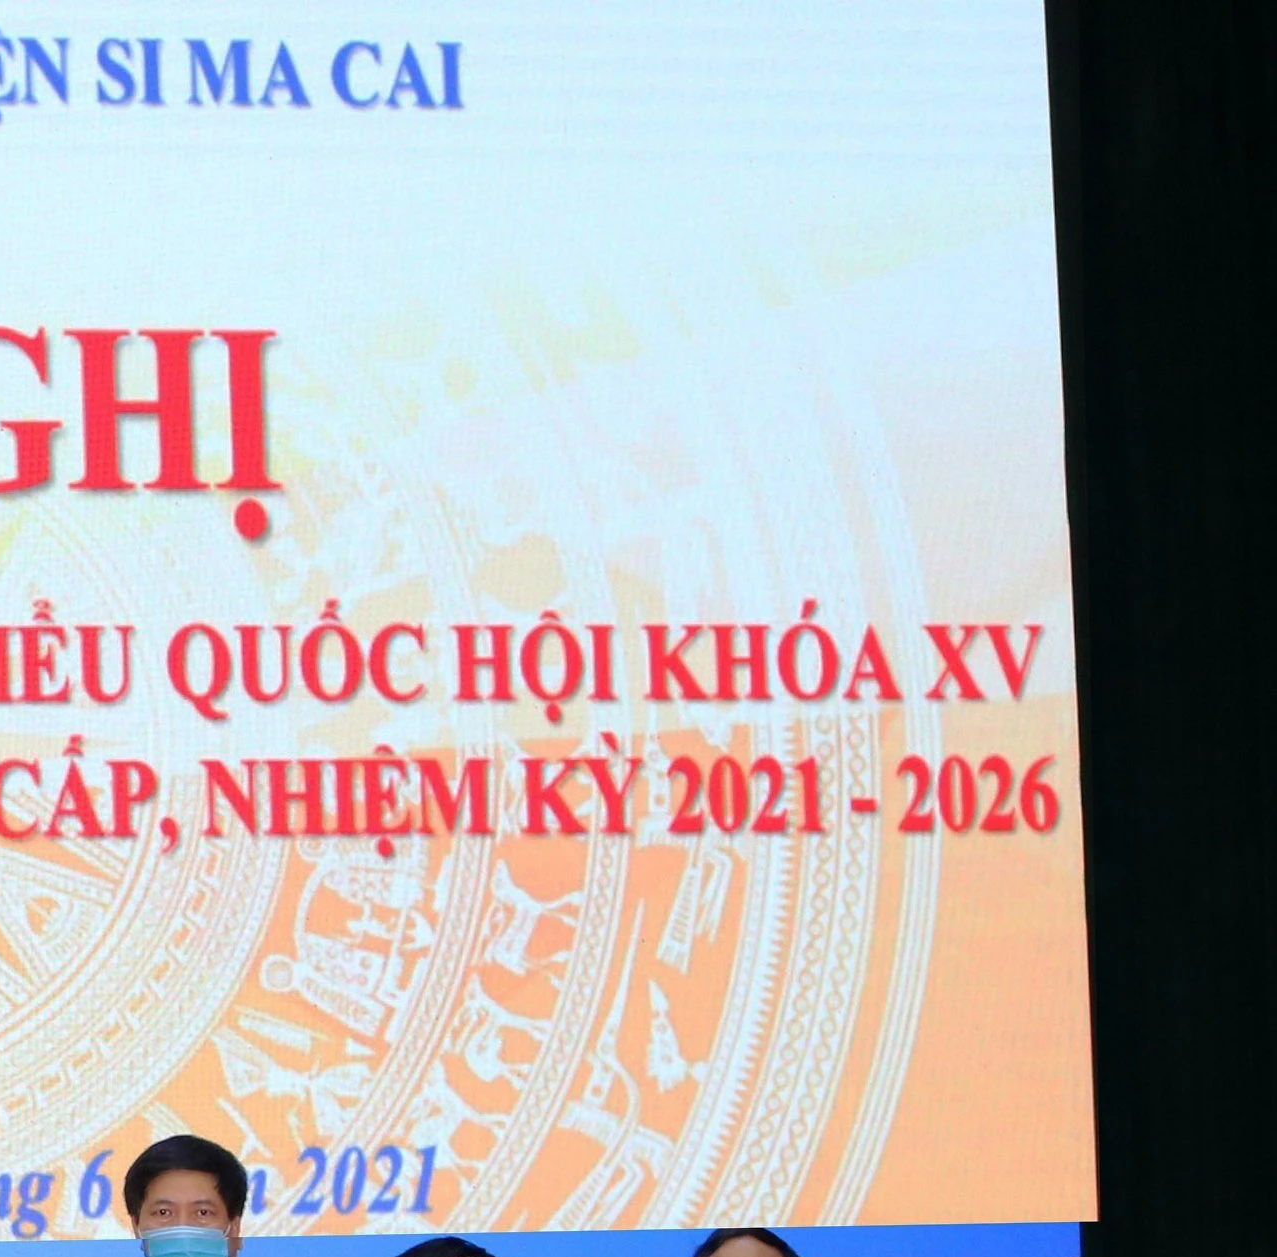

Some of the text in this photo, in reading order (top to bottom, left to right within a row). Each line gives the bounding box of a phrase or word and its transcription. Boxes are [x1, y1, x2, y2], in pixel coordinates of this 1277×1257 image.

[97, 38, 163, 104] SI
[187, 39, 310, 106] MA
[331, 41, 462, 108] CAI
[168, 601, 424, 719] QUỐC
[456, 612, 613, 721] HỘI
[646, 600, 900, 700] KHÓA
[927, 625, 1040, 699] XV
[203, 746, 493, 858] NHIỆM
[524, 733, 641, 836] KỲ
[668, 755, 823, 833] 2021
[849, 797, 879, 814] -
[900, 755, 1060, 835] 2026
[79, 1150, 113, 1217] 6
[293, 1146, 436, 1214] 2021
